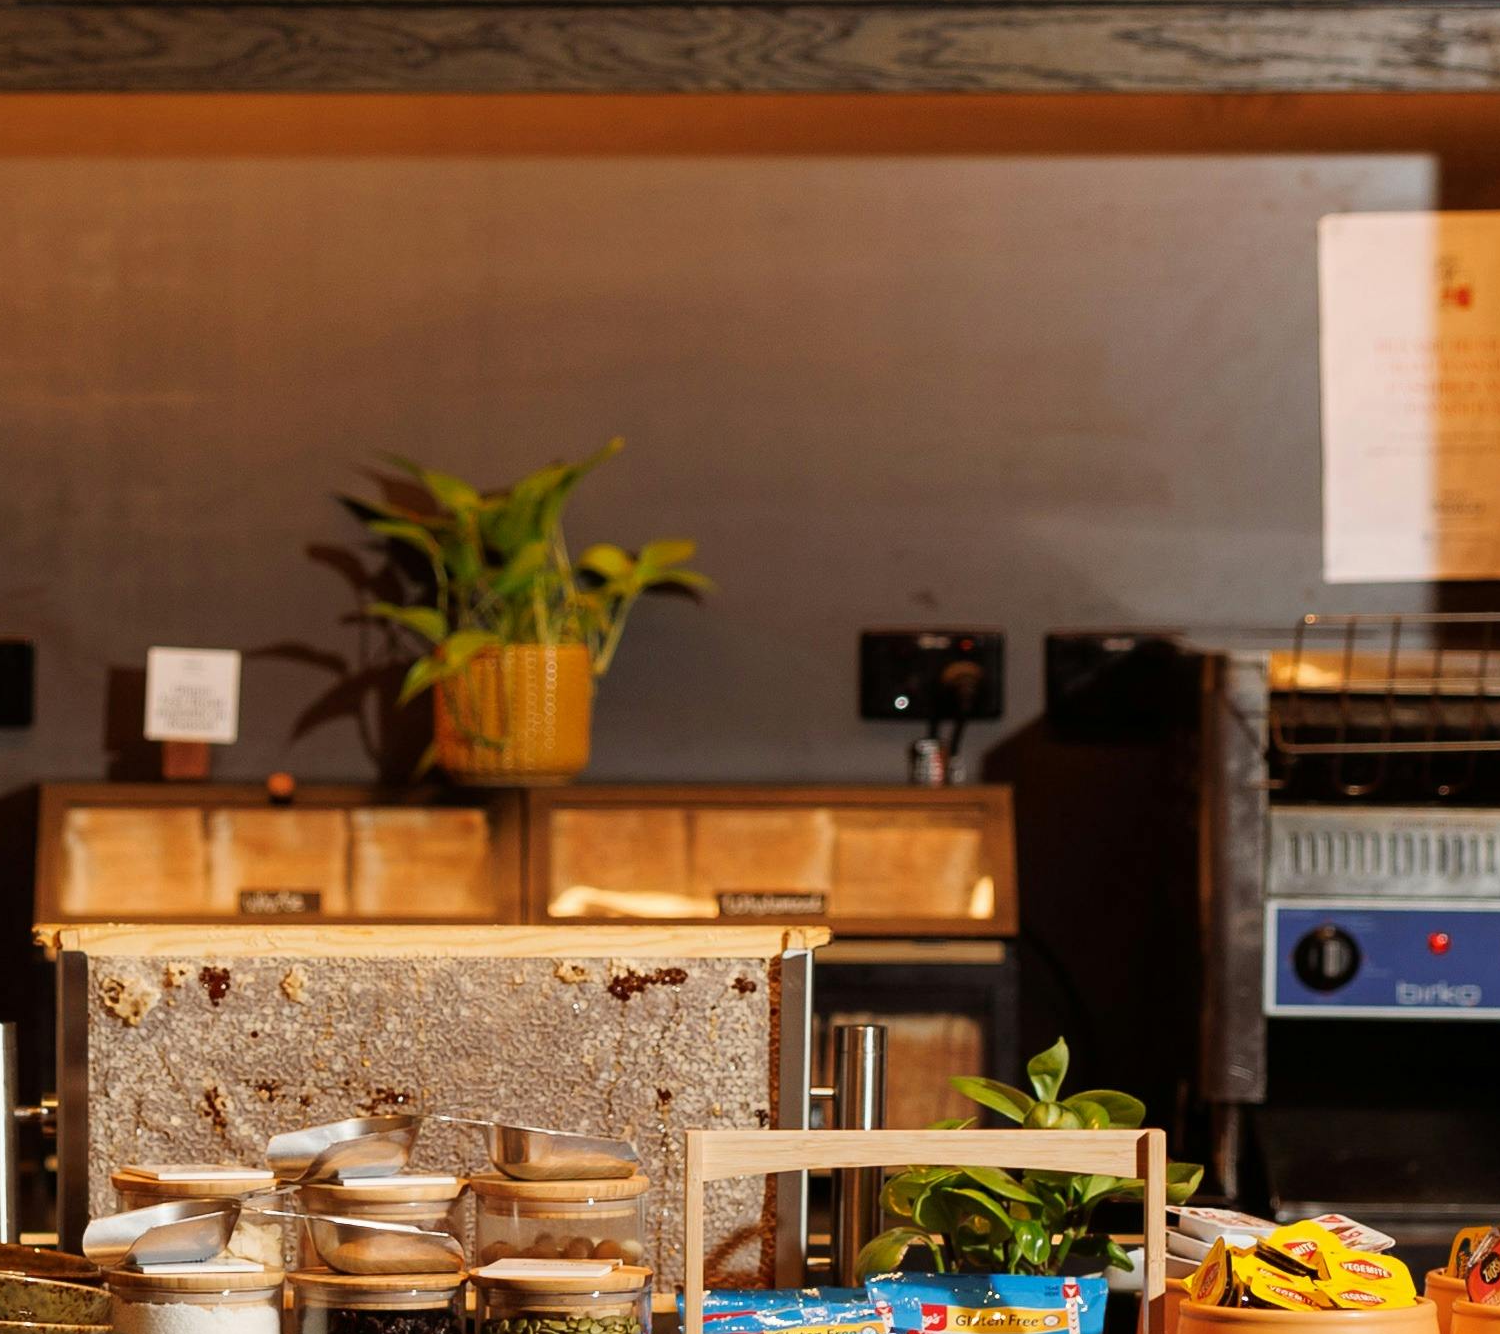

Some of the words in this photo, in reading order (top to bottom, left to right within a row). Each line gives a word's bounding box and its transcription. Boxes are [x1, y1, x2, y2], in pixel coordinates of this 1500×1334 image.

[1342, 1263, 1390, 1278] VEGEMITE
[1340, 1292, 1383, 1304] VEGEMITE
[1009, 1314, 1039, 1327] Free
